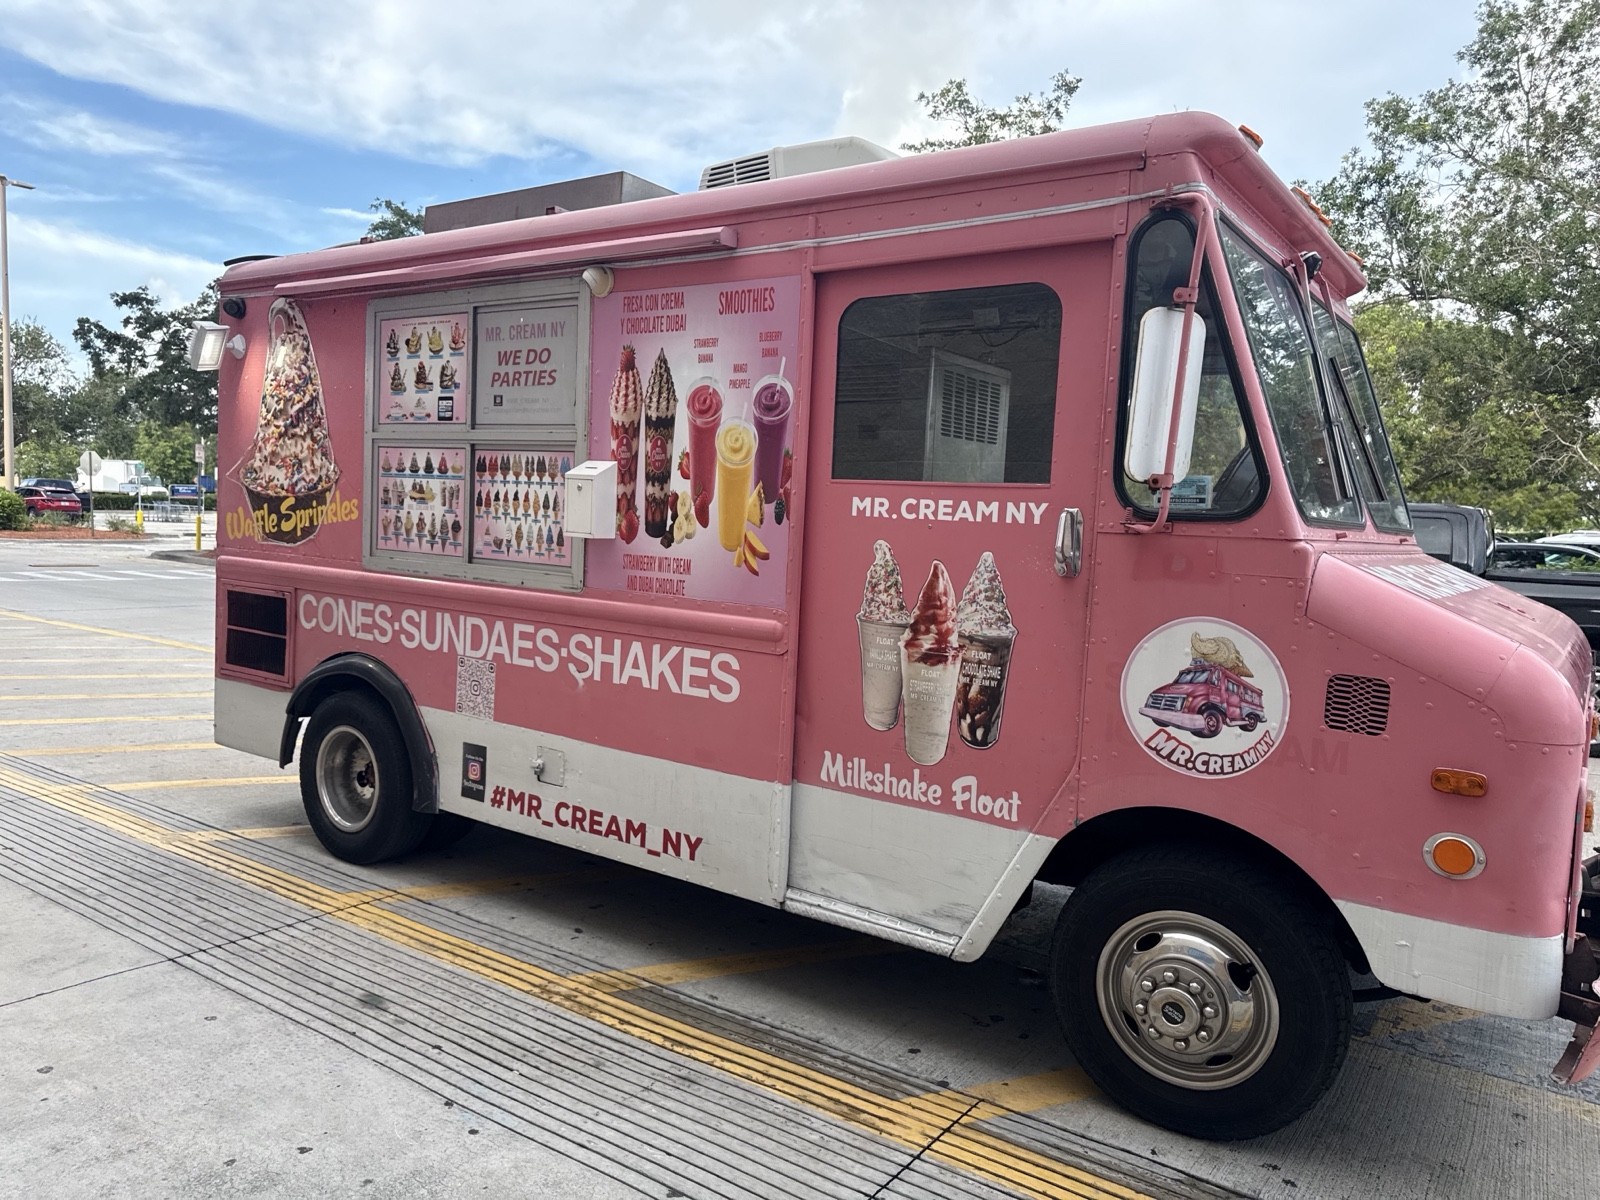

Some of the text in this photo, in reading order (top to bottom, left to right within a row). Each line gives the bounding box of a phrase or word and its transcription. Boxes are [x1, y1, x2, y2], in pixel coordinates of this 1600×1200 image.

[623, 292, 684, 312] FRESA CON CREMA
[719, 287, 775, 315] SMOOTHIES
[485, 320, 566, 342] MR. CREAM NY
[621, 314, 687, 335] Y CHOCOLATE DUBAI
[694, 338, 719, 348] STRAWBERRY
[759, 331, 782, 342] BLUEBERRY
[497, 348, 552, 366] WE DO
[733, 363, 747, 373] MANGO
[490, 369, 557, 388] PARTIES
[729, 379, 750, 389] PINEAPPLE
[226, 491, 359, 541] Waffle Sprinkles
[901, 498, 999, 523] CREAM
[1005, 502, 1049, 525] NY
[622, 553, 691, 575] STRAWBERRY WITH CREAM
[627, 575, 686, 597] AND DUBAI CHOCOLATE
[876, 636, 895, 646] FLOAT
[971, 649, 992, 661] FLOAT
[920, 669, 941, 678] FLOAT
[990, 680, 999, 688] NY
[1194, 746, 1260, 775] CREAM
[1255, 729, 1275, 758] NY
[820, 751, 1021, 821] Milkshake Float
[490, 785, 703, 862] #MR_CREAM_NY
